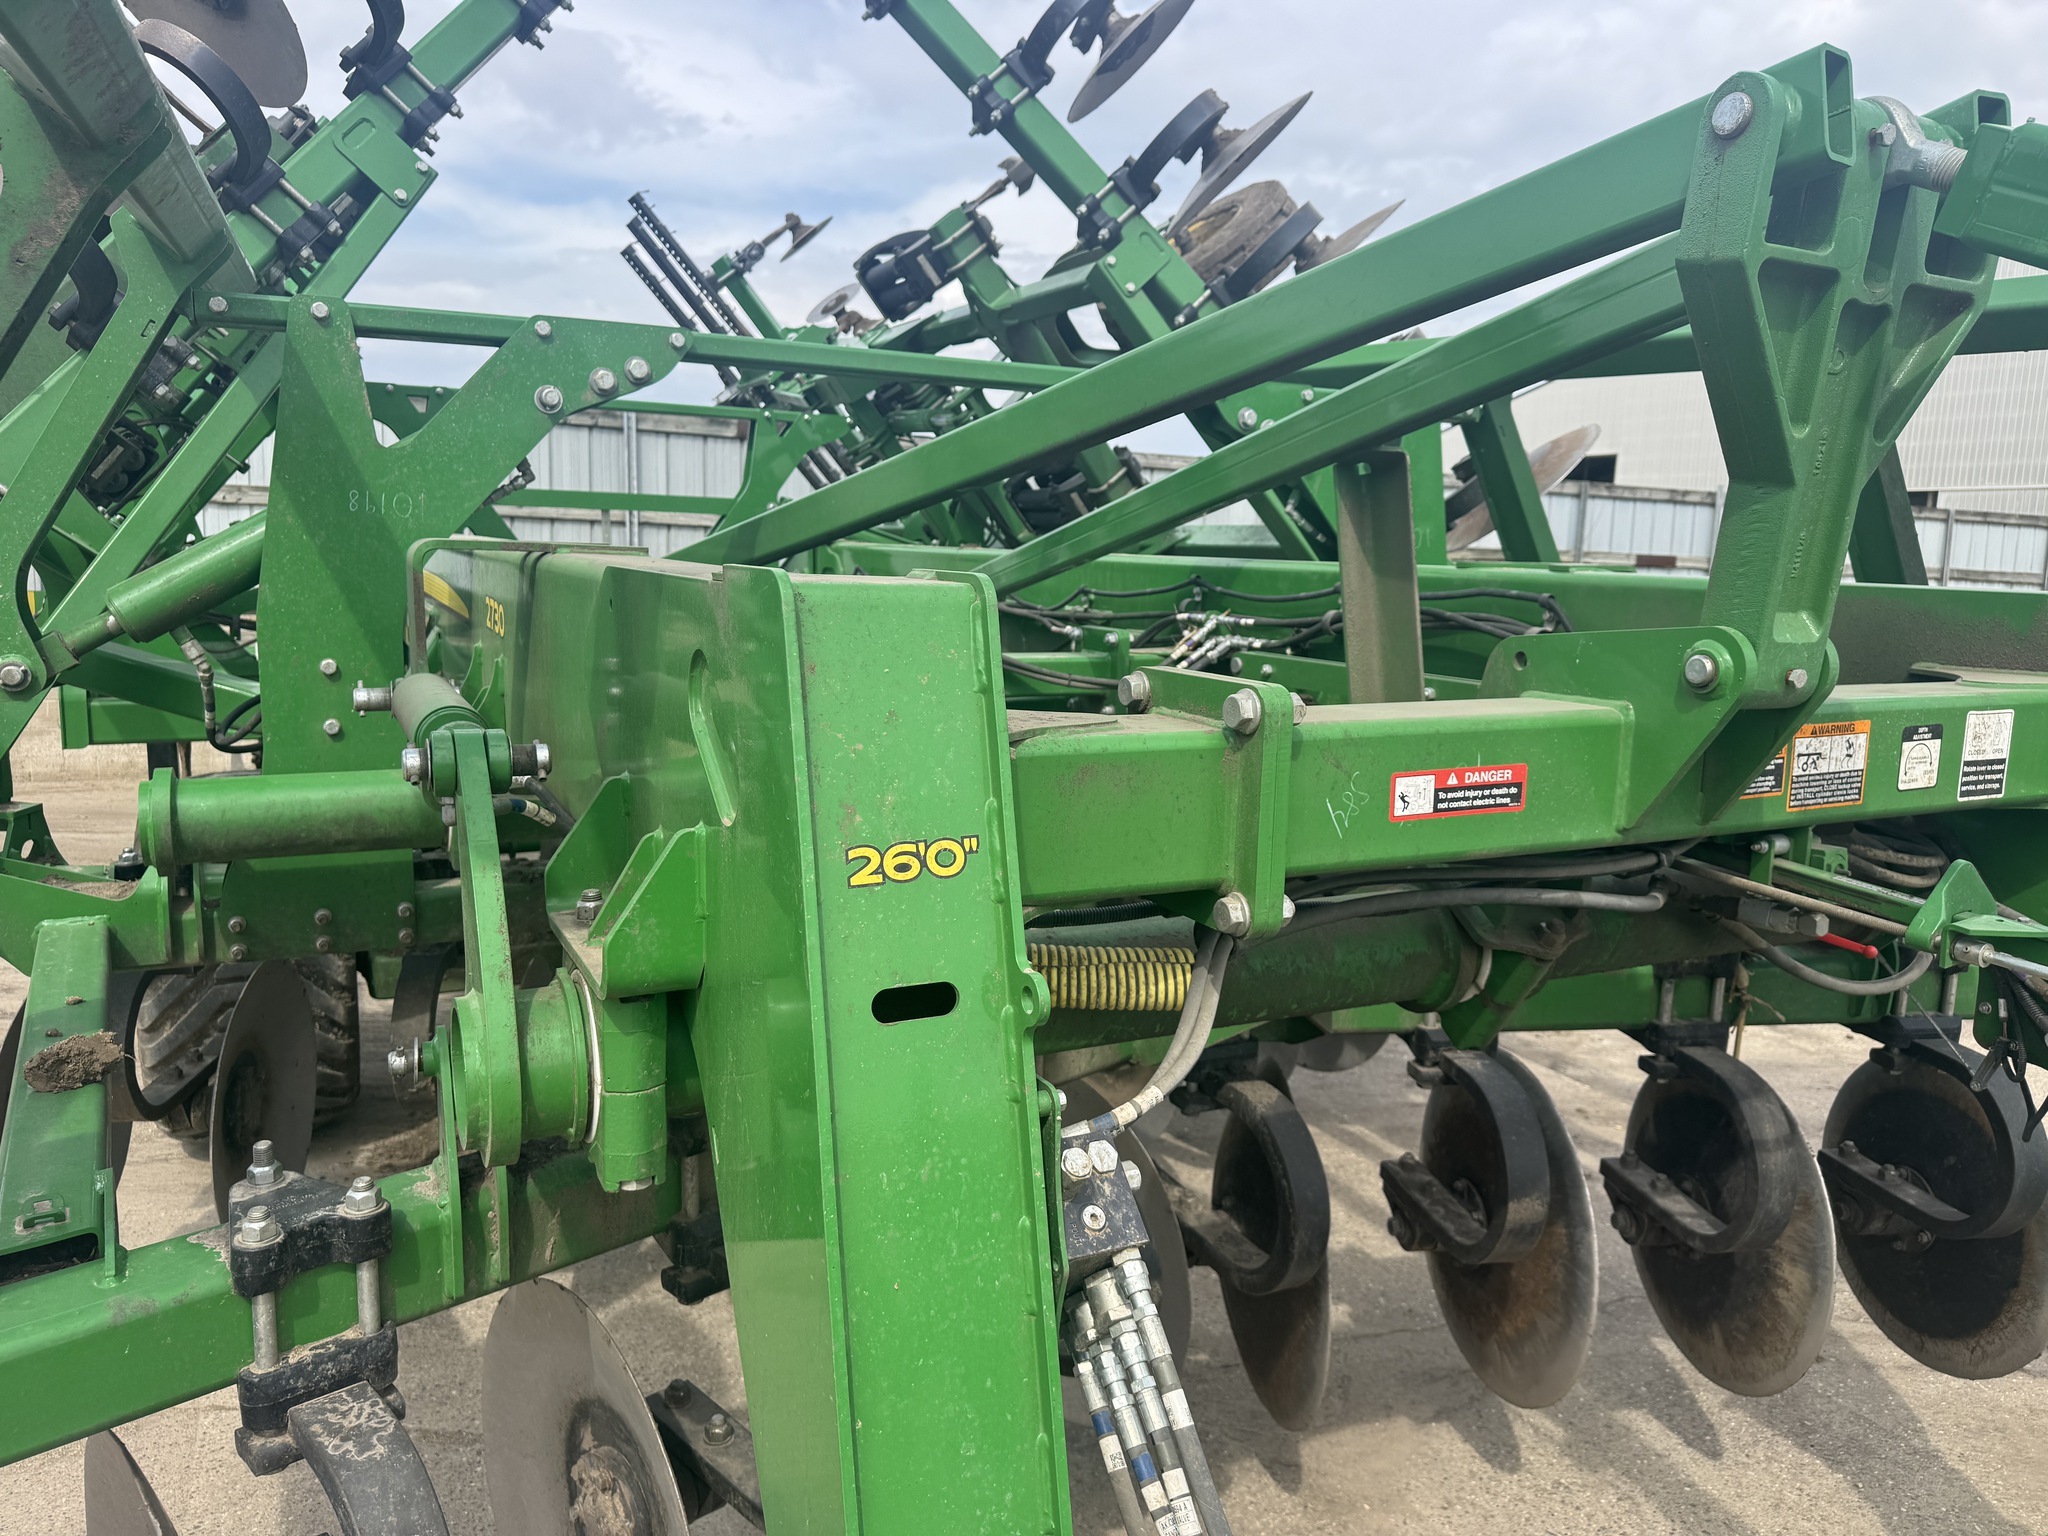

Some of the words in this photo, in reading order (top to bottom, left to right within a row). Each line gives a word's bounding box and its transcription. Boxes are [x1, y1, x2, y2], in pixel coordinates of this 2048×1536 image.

[485, 595, 506, 638] 2730
[1817, 723, 1856, 735] WARNING
[1464, 769, 1513, 784] DANGER
[1962, 774, 1979, 783] position
[1438, 791, 1447, 799] To
[1447, 789, 1465, 799] avoid
[1465, 789, 1483, 798] injury
[1491, 787, 1509, 795] death
[1508, 786, 1518, 794] do
[1437, 801, 1449, 809] not
[1448, 799, 1473, 808] contact
[1472, 797, 1496, 806] electric
[1495, 796, 1511, 804] lines
[845, 834, 980, 890] 26'0"
